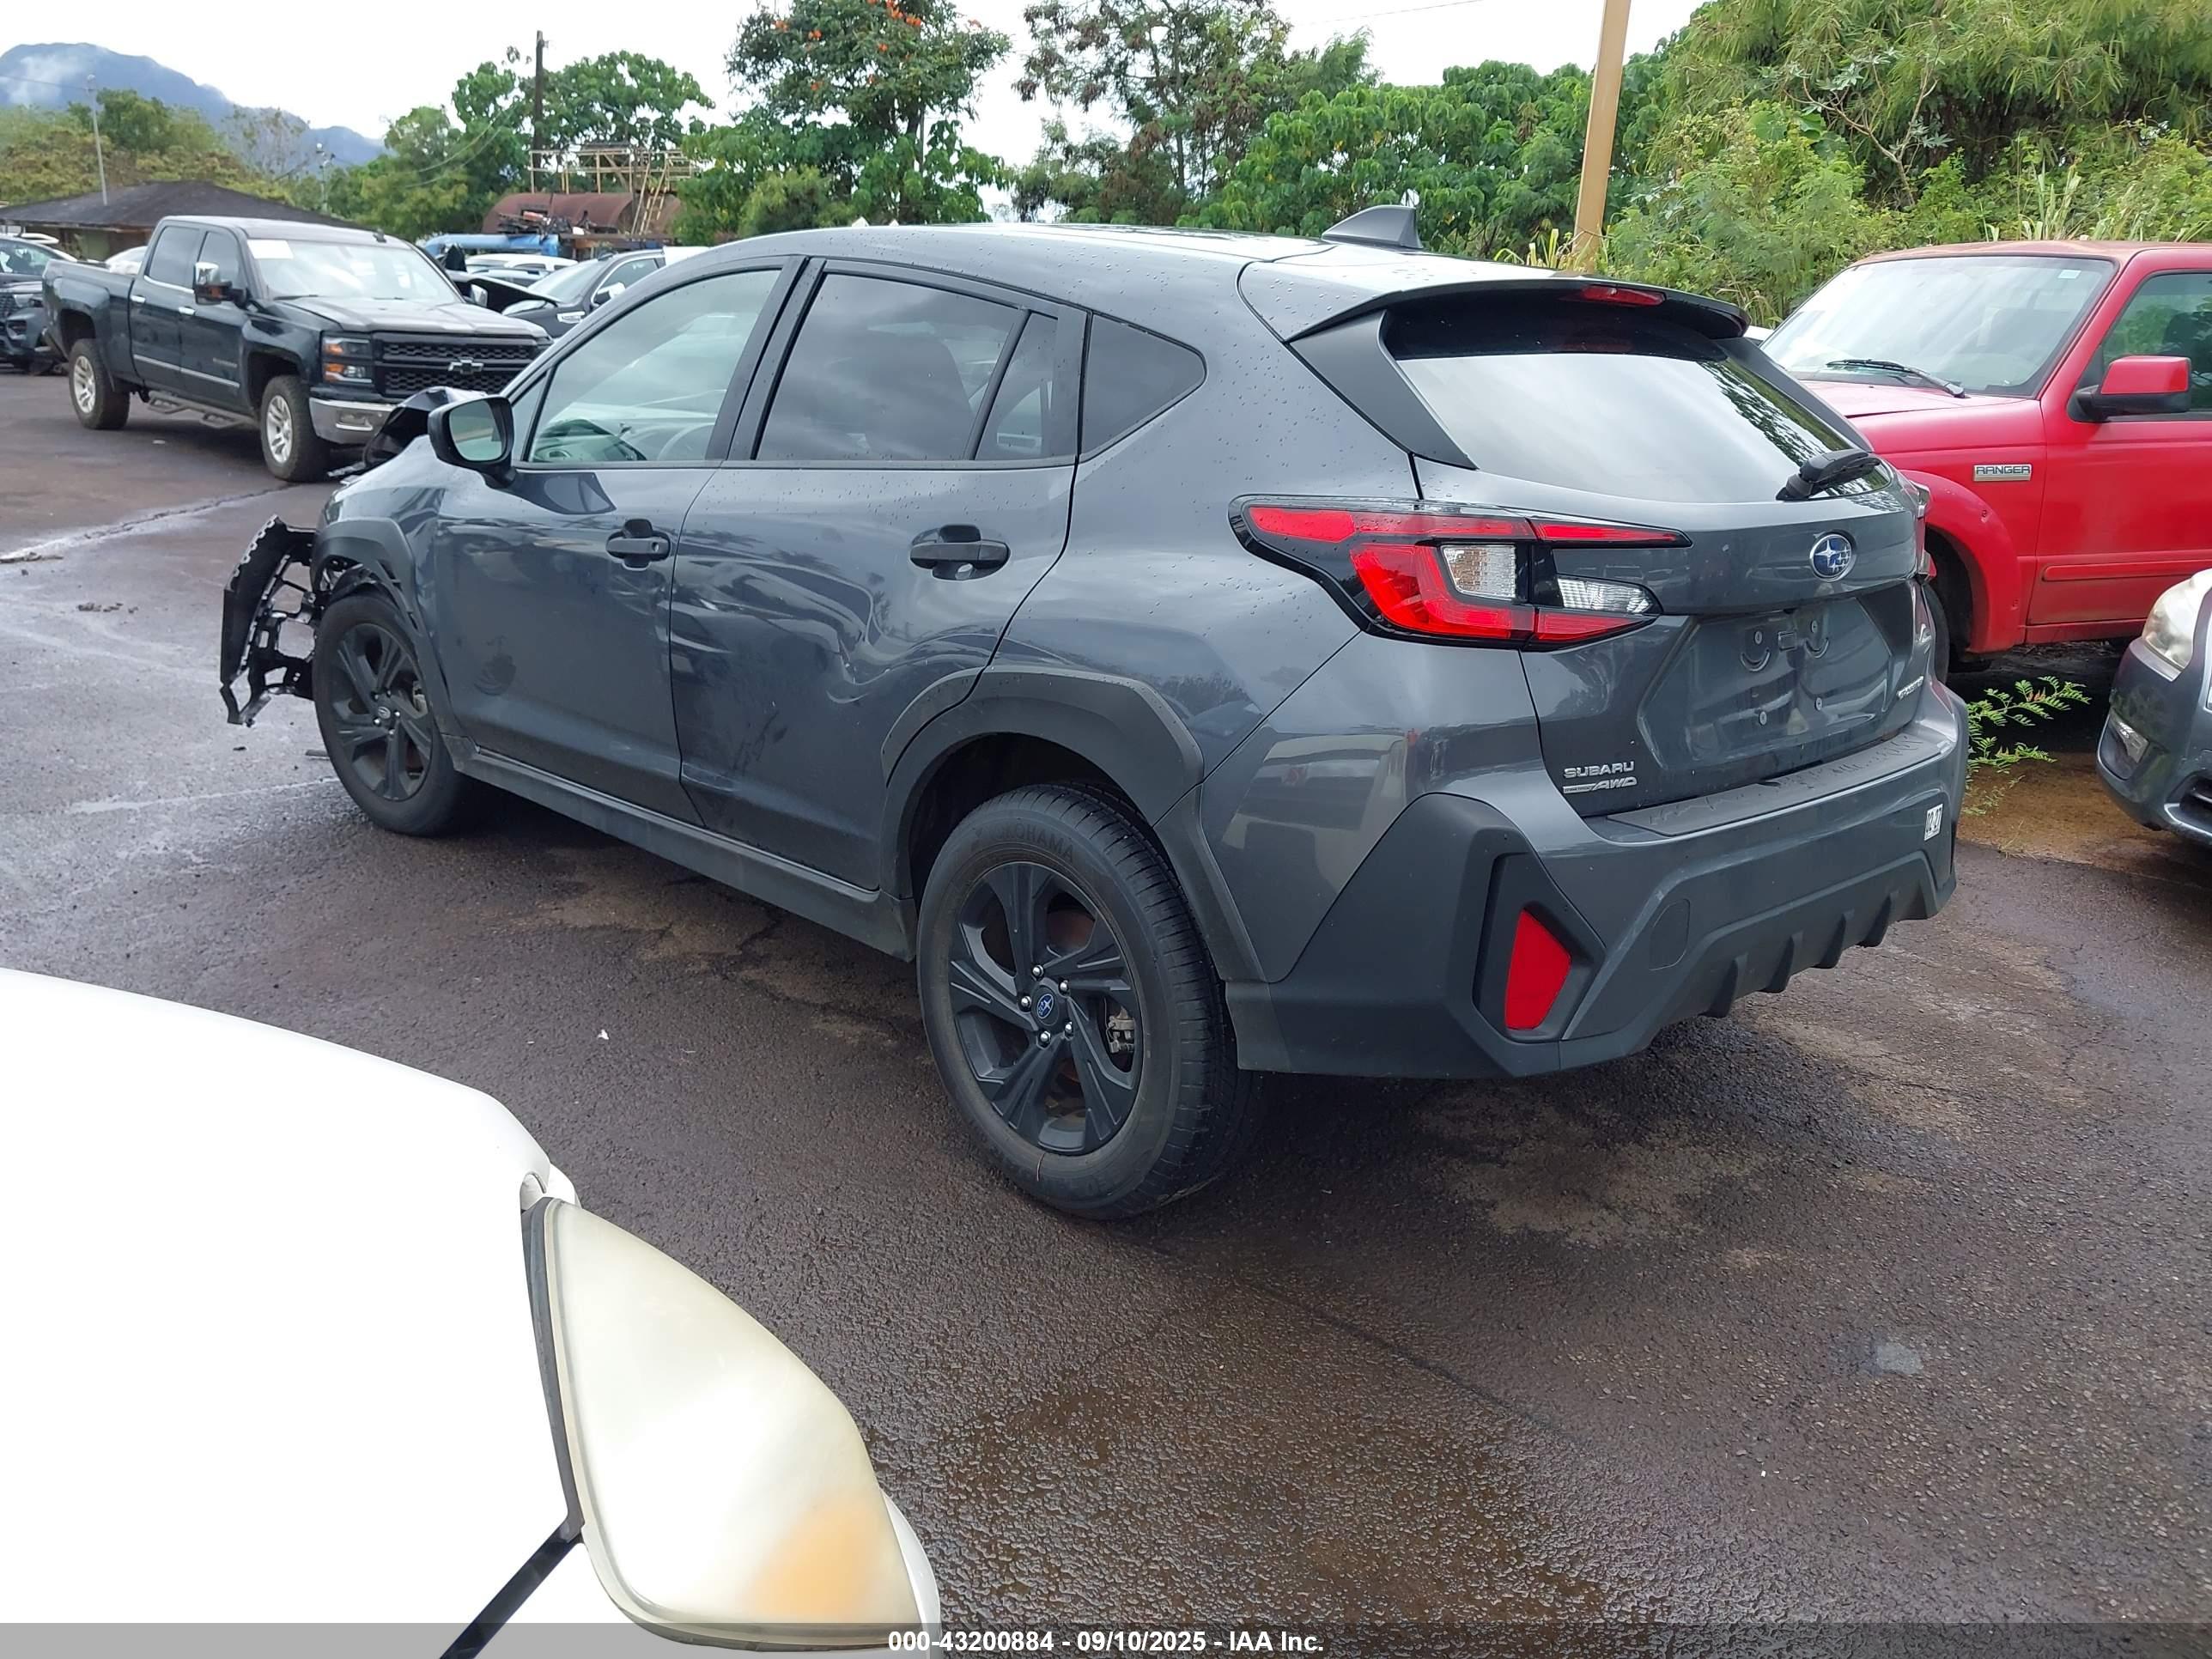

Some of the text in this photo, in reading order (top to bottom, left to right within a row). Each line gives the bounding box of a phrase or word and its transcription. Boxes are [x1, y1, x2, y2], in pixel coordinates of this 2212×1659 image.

[1976, 465, 2030, 475] RANGER
[1564, 761, 1635, 779] SUBARU
[1593, 776, 1638, 791] AWD
